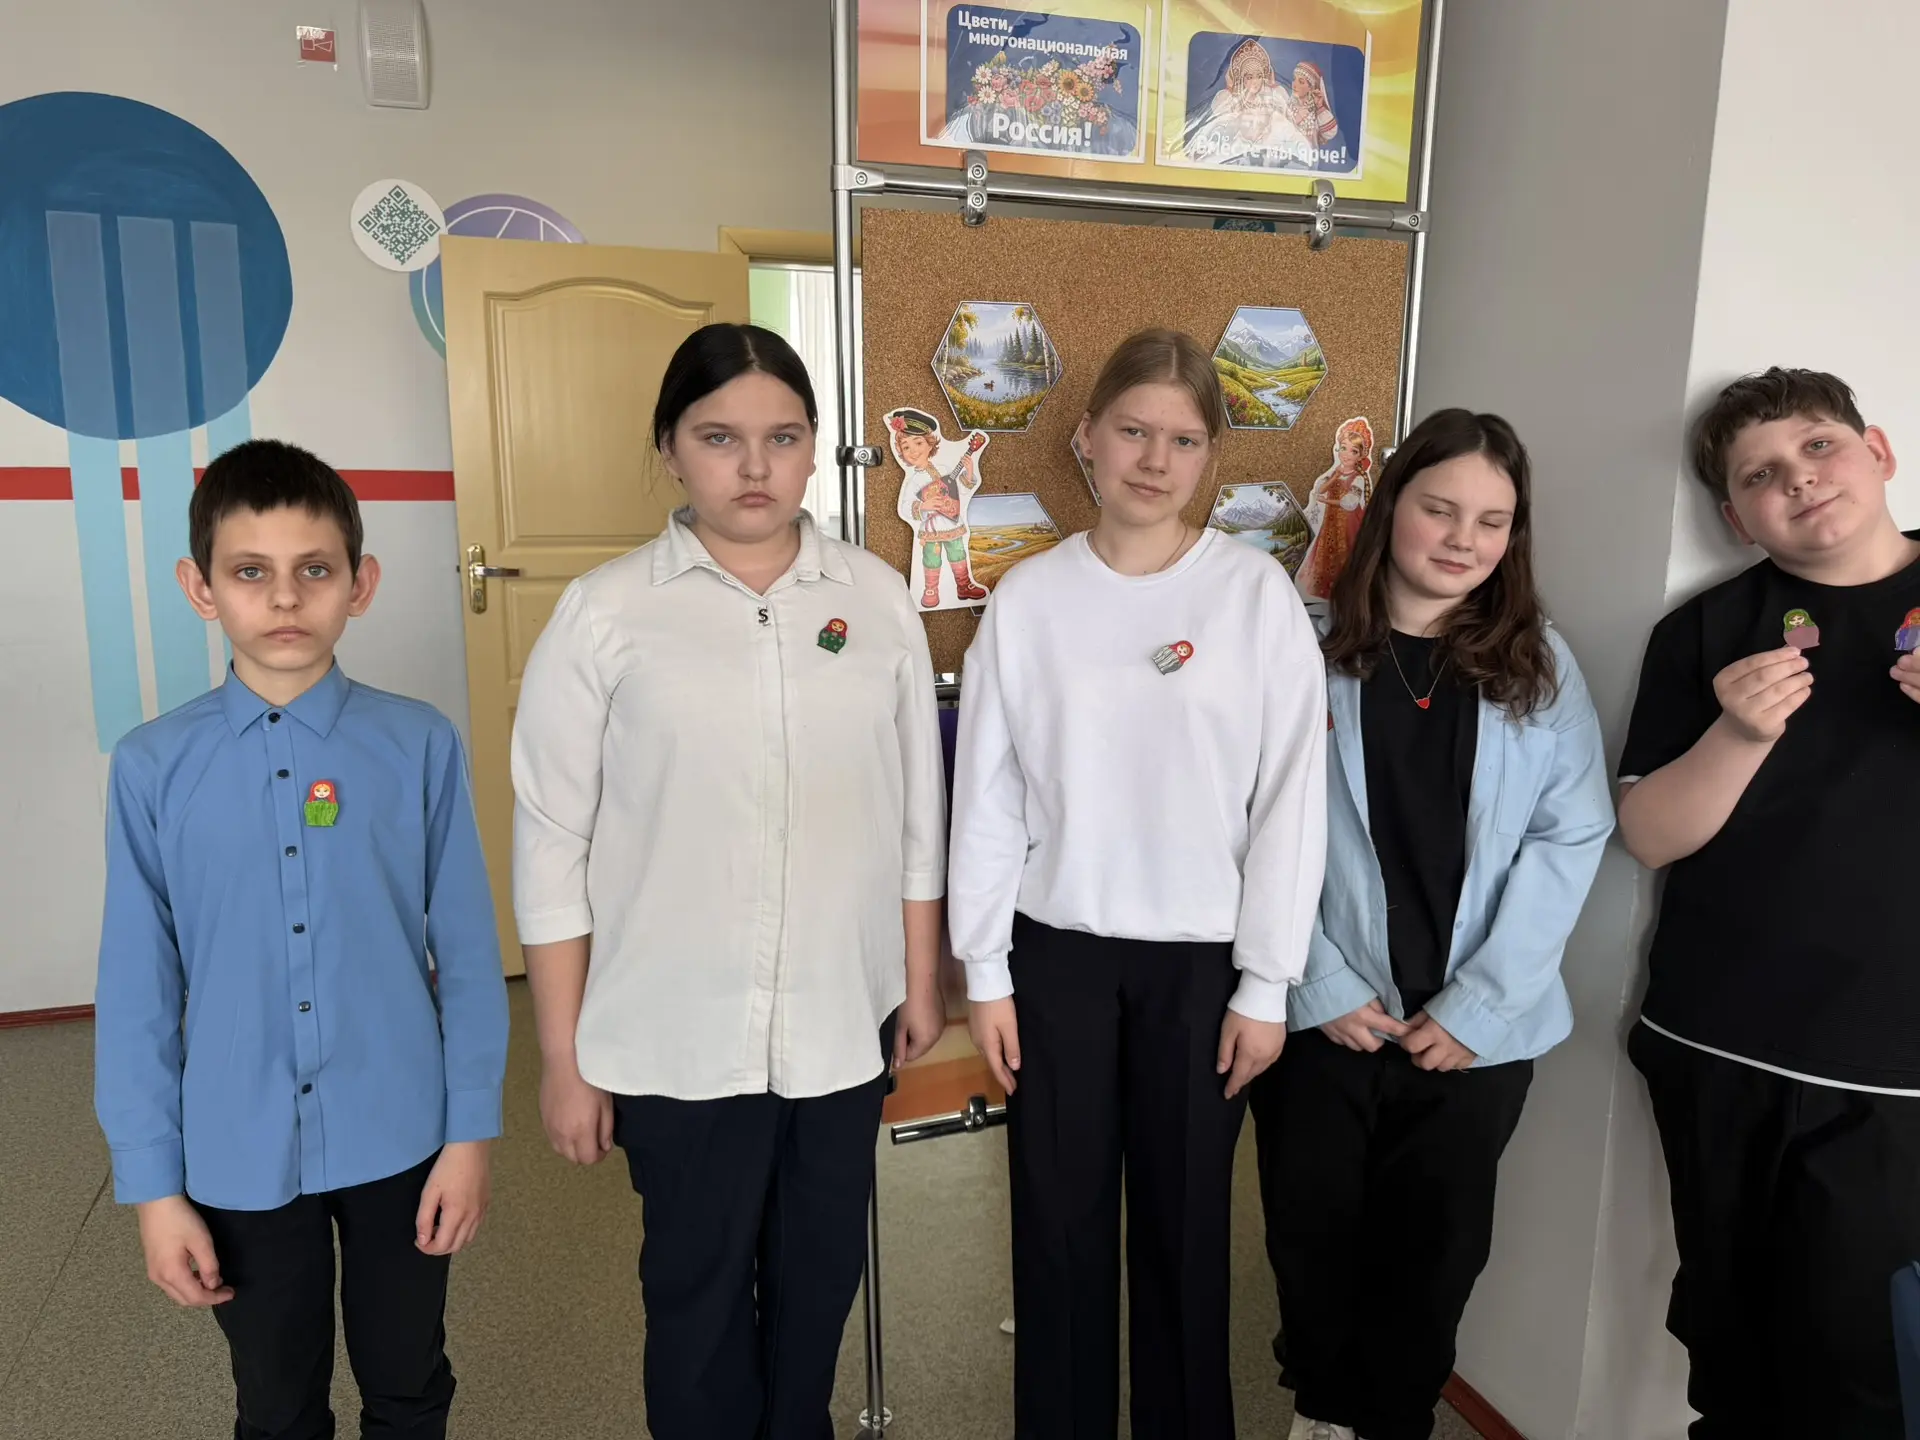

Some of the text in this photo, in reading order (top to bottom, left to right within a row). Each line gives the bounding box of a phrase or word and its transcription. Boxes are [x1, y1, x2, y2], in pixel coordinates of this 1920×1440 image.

[958, 10, 1013, 32] Цвети,
[969, 32, 1128, 60] многонациональная
[992, 112, 1092, 147] Россия!
